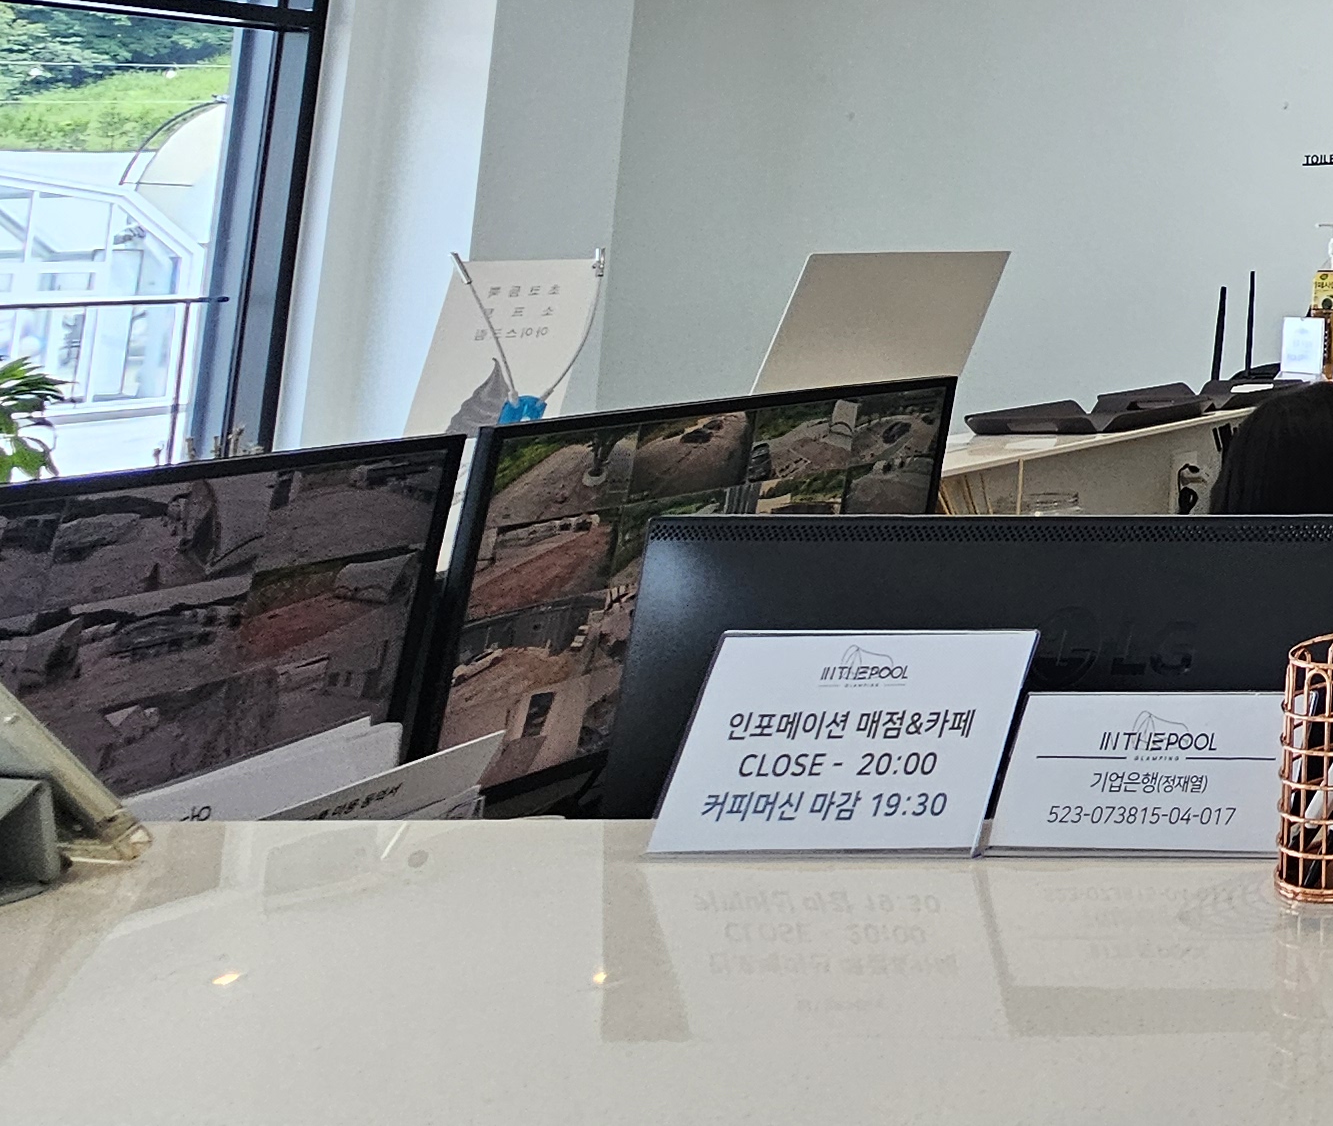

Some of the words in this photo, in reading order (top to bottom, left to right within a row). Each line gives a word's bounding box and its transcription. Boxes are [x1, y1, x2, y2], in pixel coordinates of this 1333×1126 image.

[728, 711, 850, 740] 인포메이션
[856, 710, 976, 739] 매점&카페
[739, 753, 826, 777] CLOSE
[856, 752, 937, 775] 20:00
[1090, 772, 1207, 793] 기업은행(정재열)
[702, 791, 804, 821] 커피머신
[810, 791, 861, 821] 마감
[873, 793, 947, 816] 19:30
[1047, 806, 1236, 825] 523-073815-04-017
